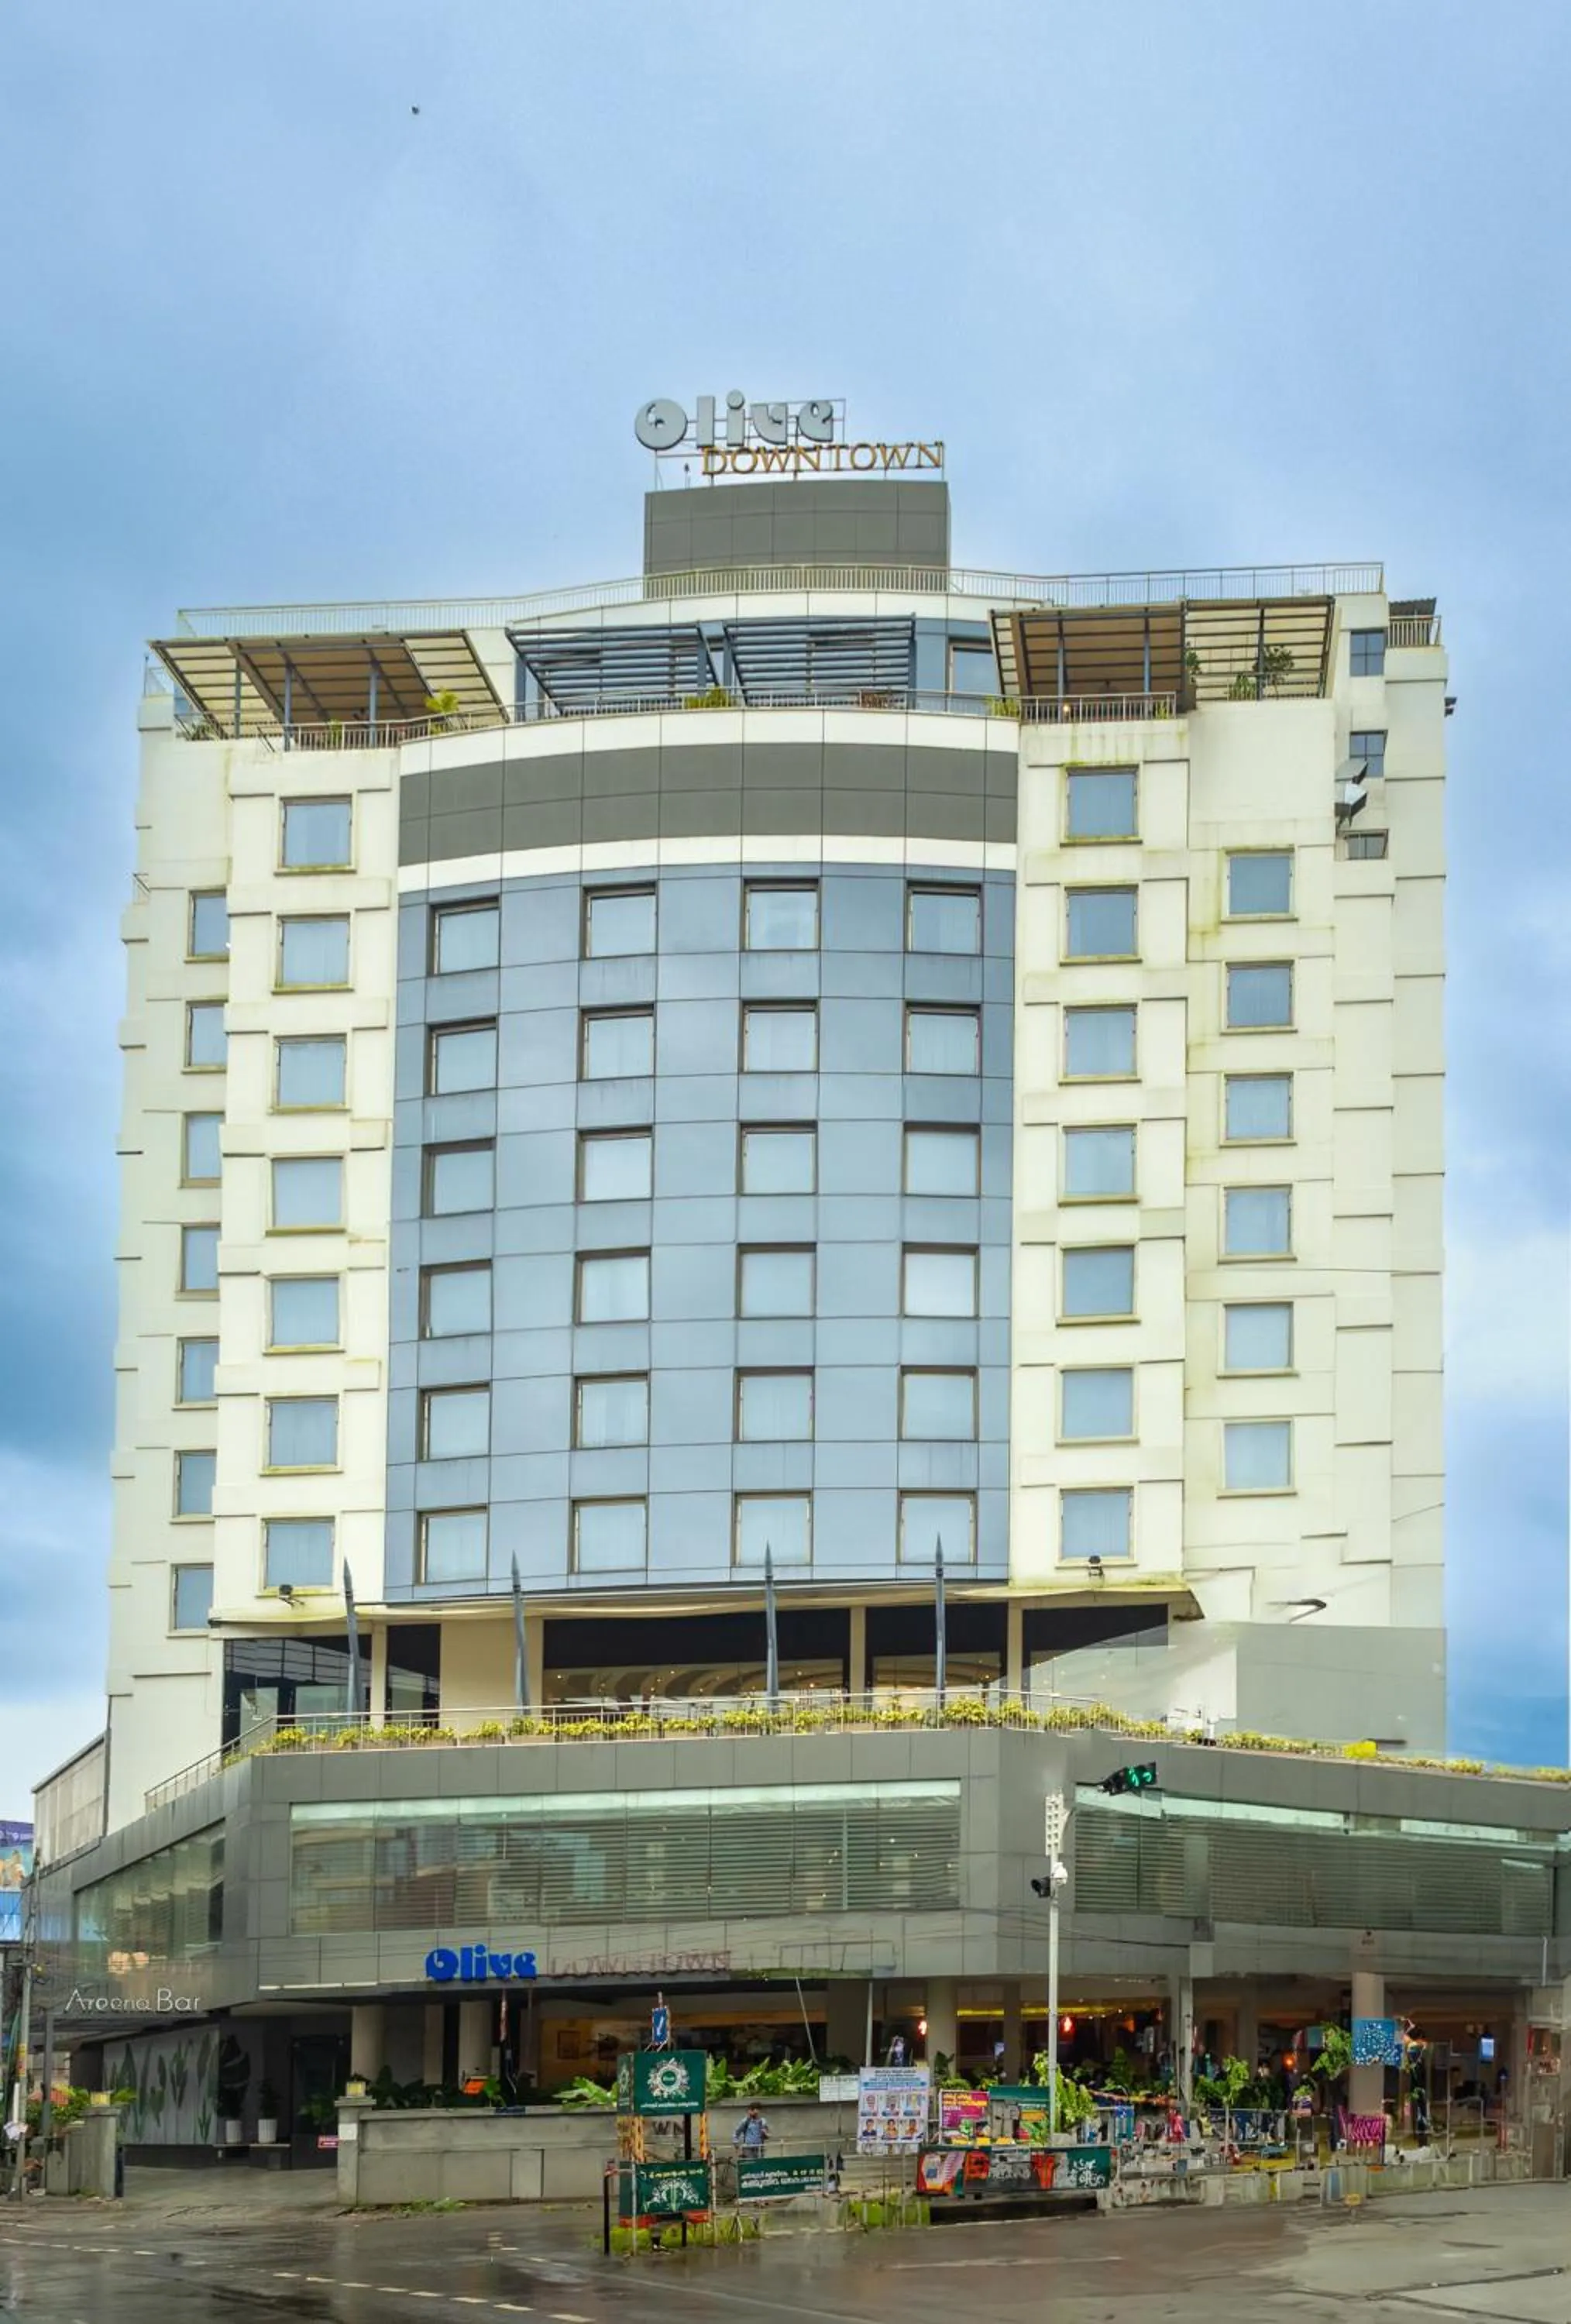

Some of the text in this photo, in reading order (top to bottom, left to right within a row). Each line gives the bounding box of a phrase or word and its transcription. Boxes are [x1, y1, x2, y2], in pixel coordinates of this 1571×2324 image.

[634, 390, 834, 450] Olive
[701, 442, 944, 475] DOWNTOWN
[425, 1944, 537, 1982] Olive
[156, 1987, 201, 2013] Bar
